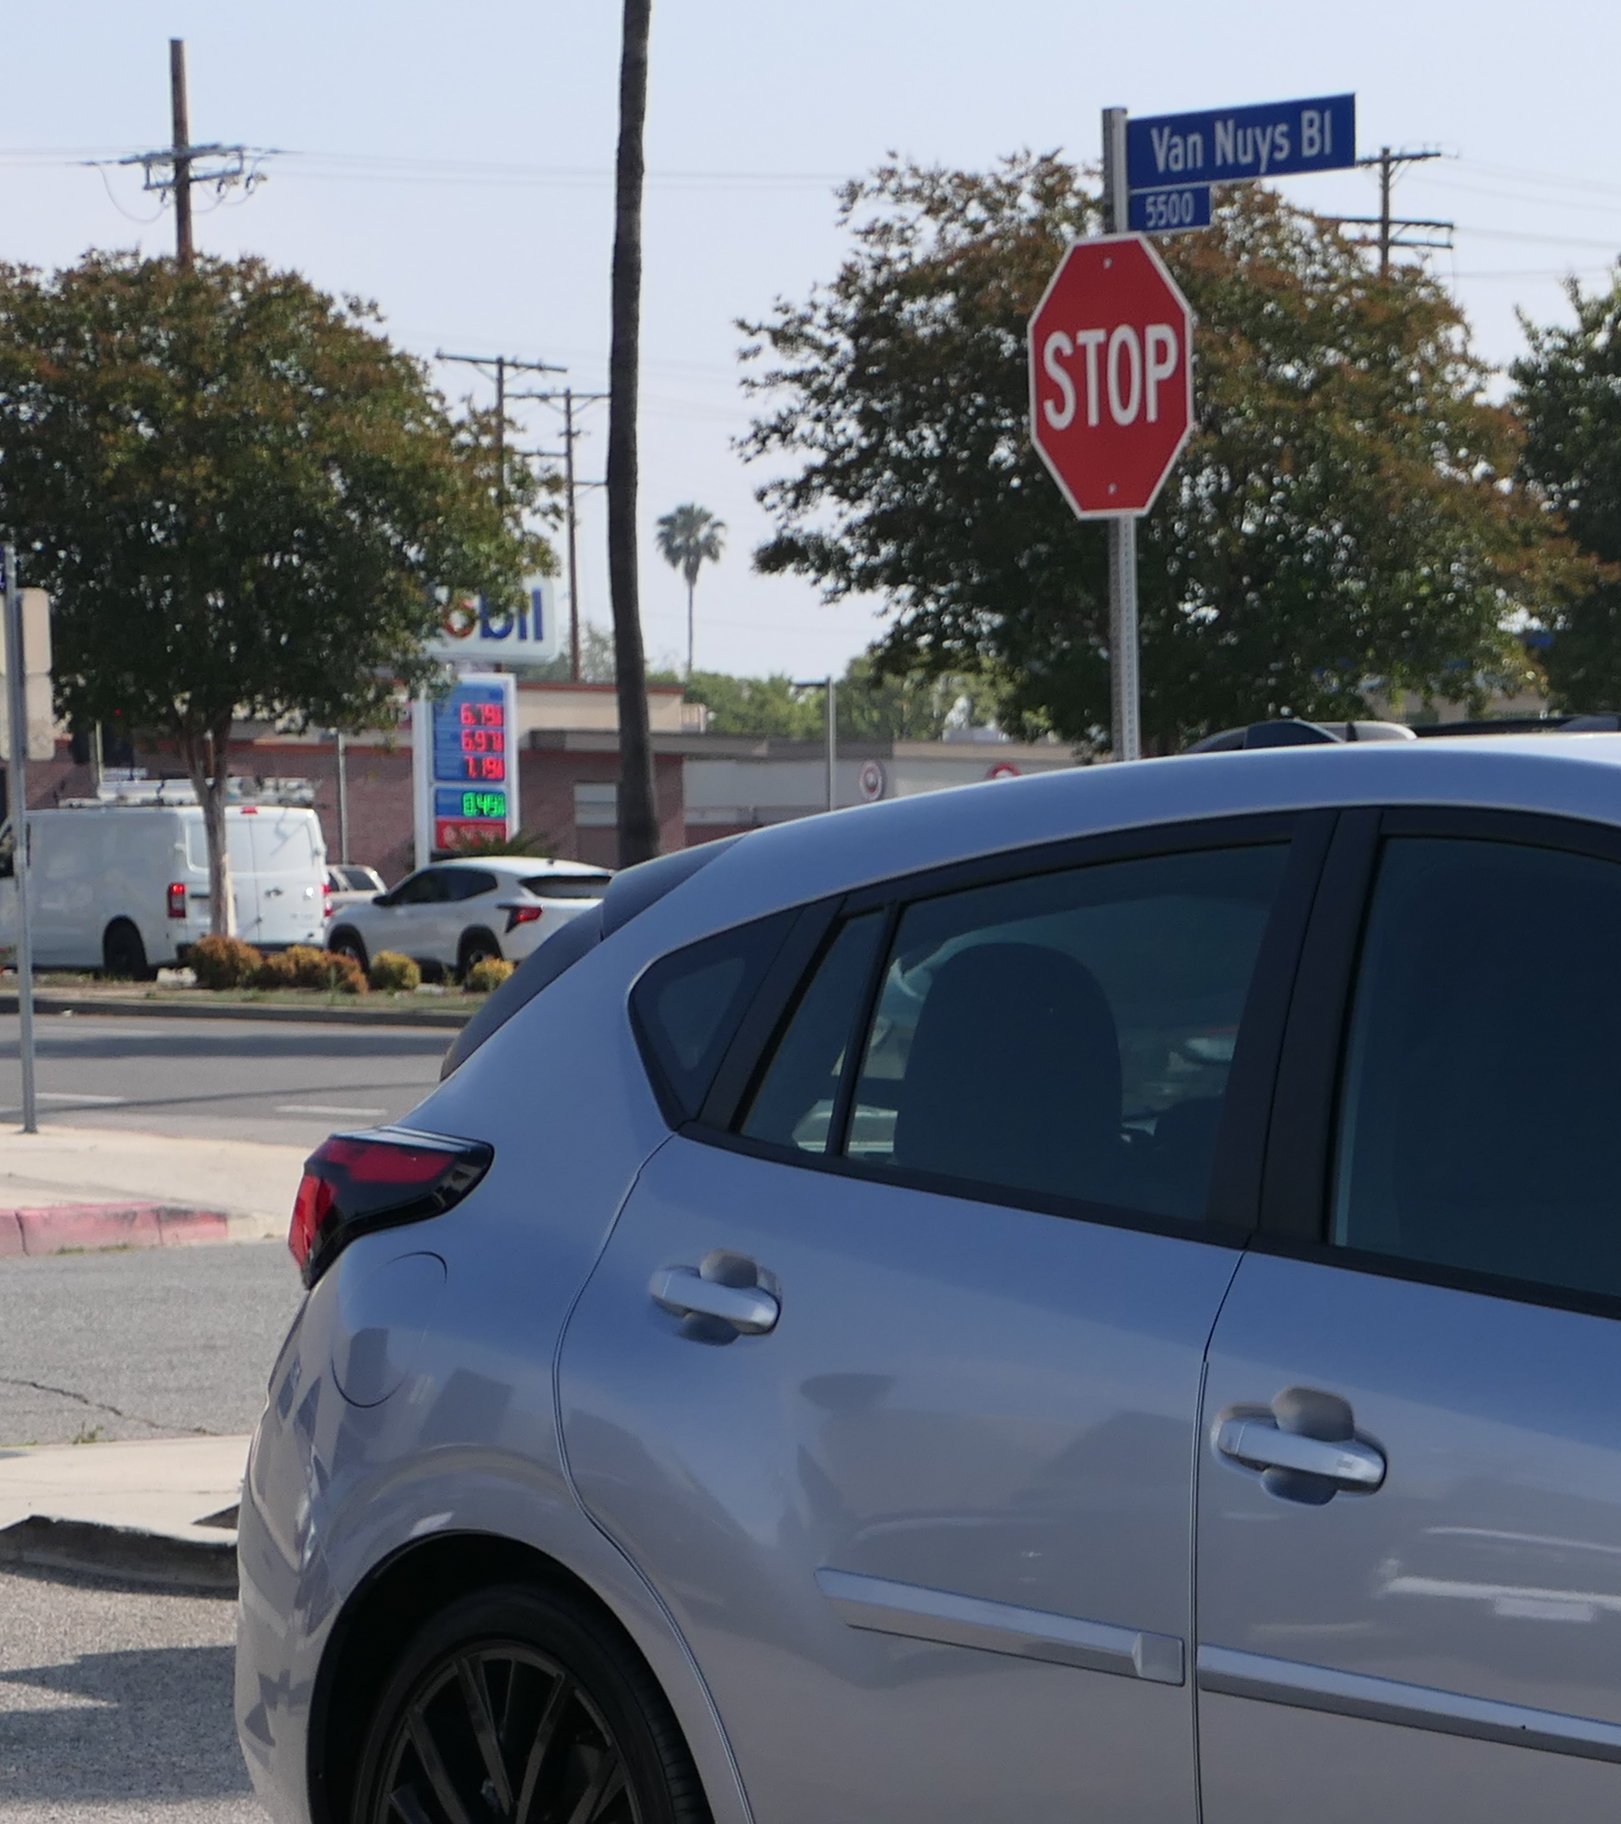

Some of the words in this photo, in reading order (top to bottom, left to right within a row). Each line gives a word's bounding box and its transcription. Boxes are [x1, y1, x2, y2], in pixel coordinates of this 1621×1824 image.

[1151, 126, 1204, 174] Van
[1214, 118, 1291, 174] Nuys
[1145, 191, 1194, 228] 5500
[1043, 323, 1179, 431] STOP
